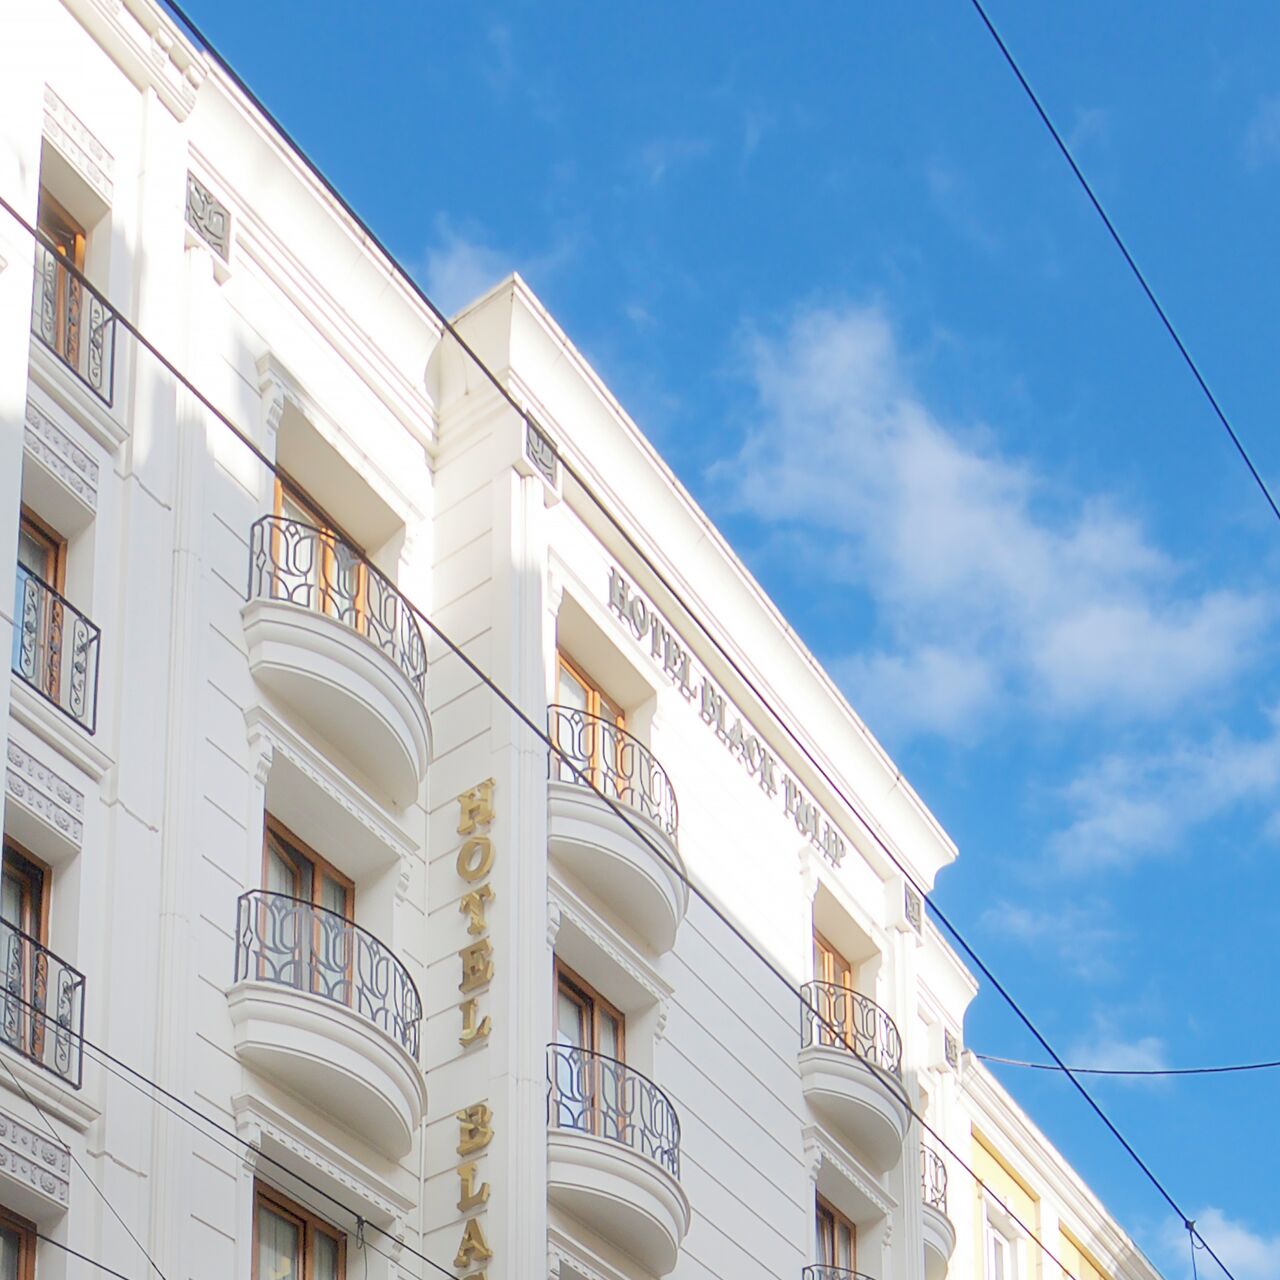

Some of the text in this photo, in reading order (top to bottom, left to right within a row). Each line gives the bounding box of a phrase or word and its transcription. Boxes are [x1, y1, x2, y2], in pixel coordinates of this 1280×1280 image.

[607, 565, 846, 868] HOTEL BLACK TULIP
[456, 776, 496, 1049] HOTEL
